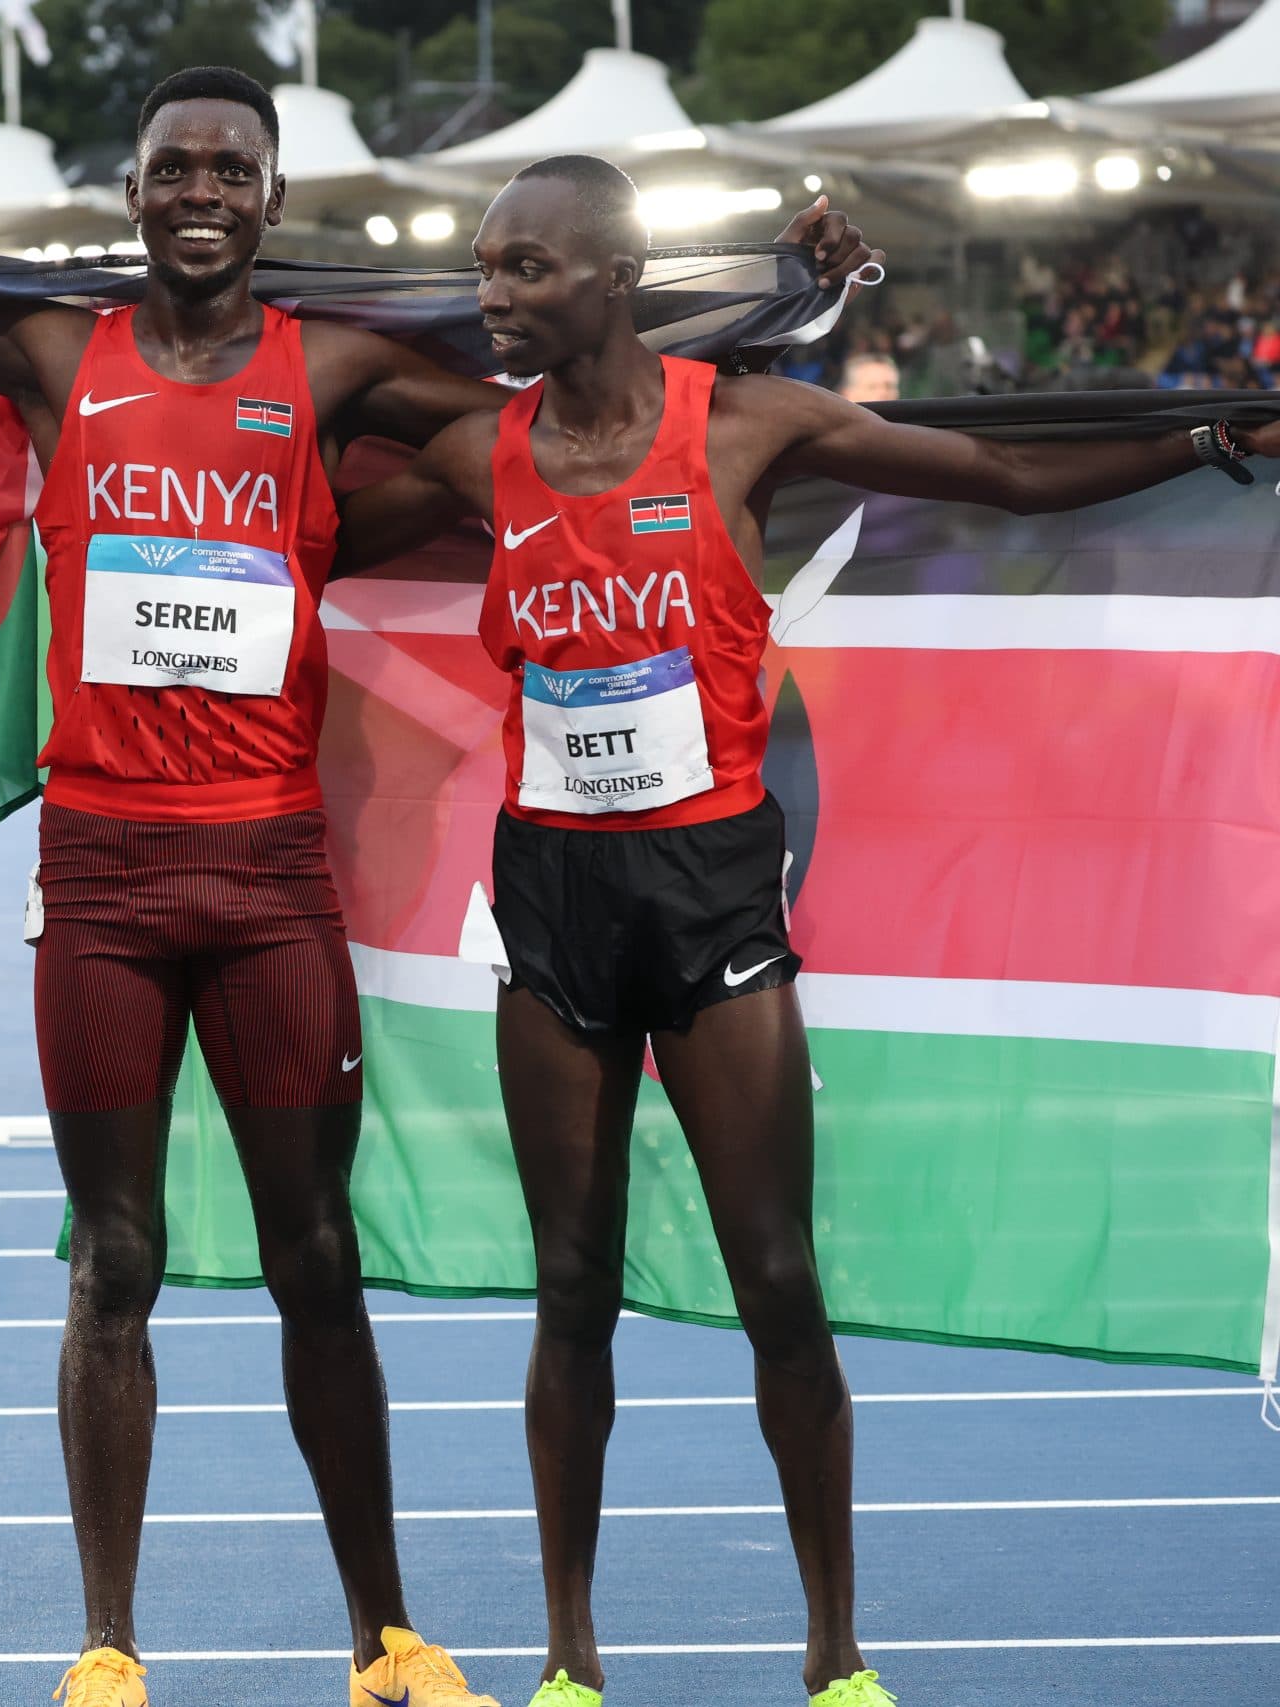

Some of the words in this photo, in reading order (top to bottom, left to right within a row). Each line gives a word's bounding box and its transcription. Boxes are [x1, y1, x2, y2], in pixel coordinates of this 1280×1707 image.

[86, 463, 278, 532] KENYA
[192, 548, 254, 561] commonwealth
[209, 556, 238, 565] games
[135, 600, 238, 634] SEREM
[508, 570, 696, 641] KENYA
[131, 650, 238, 673] LONGINES
[608, 678, 637, 689] games
[565, 728, 637, 758] BETT
[564, 772, 664, 796] LONGINES
